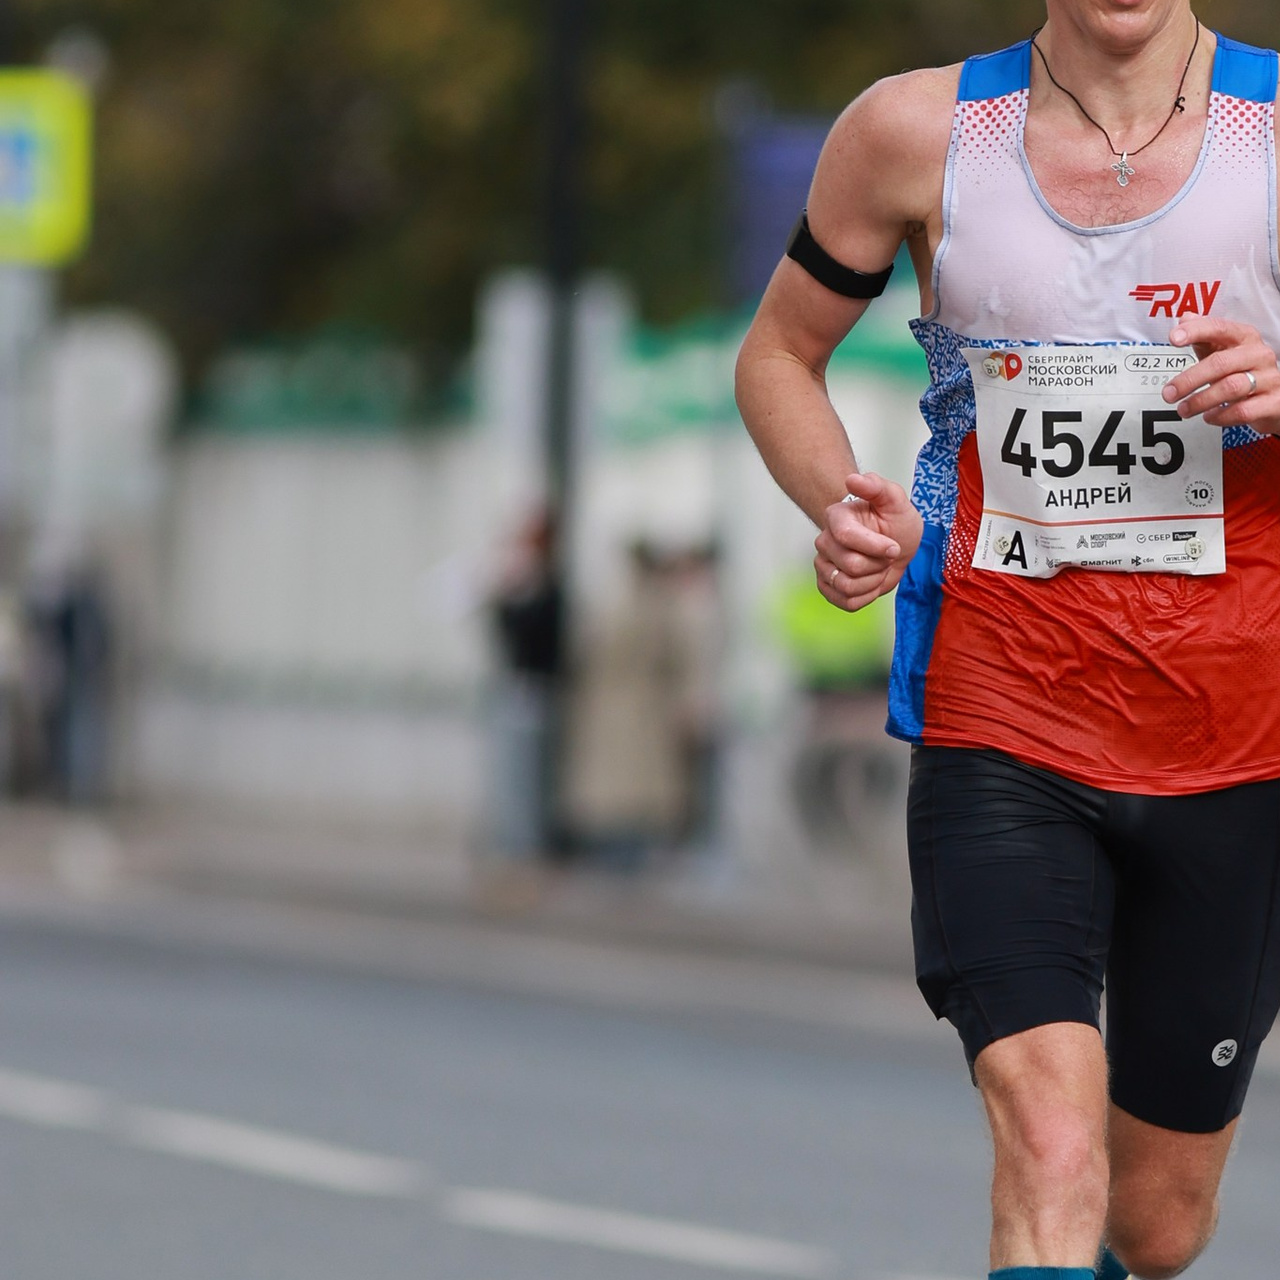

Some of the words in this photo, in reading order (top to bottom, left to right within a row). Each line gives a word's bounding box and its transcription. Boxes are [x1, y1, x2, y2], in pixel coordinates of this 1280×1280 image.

[1128, 281, 1221, 317] RAY
[1028, 354, 1093, 363] СБЕРПРАЙМ
[1132, 358, 1160, 369] 42,2
[1028, 363, 1117, 375] МОСКОВСКИЙ
[1028, 377, 1093, 386] МАРАФОН
[1141, 375, 1170, 386] 202
[1001, 407, 1185, 478] 4545
[1045, 482, 1132, 509] АНДРЕЙ
[1191, 488, 1209, 499] 10
